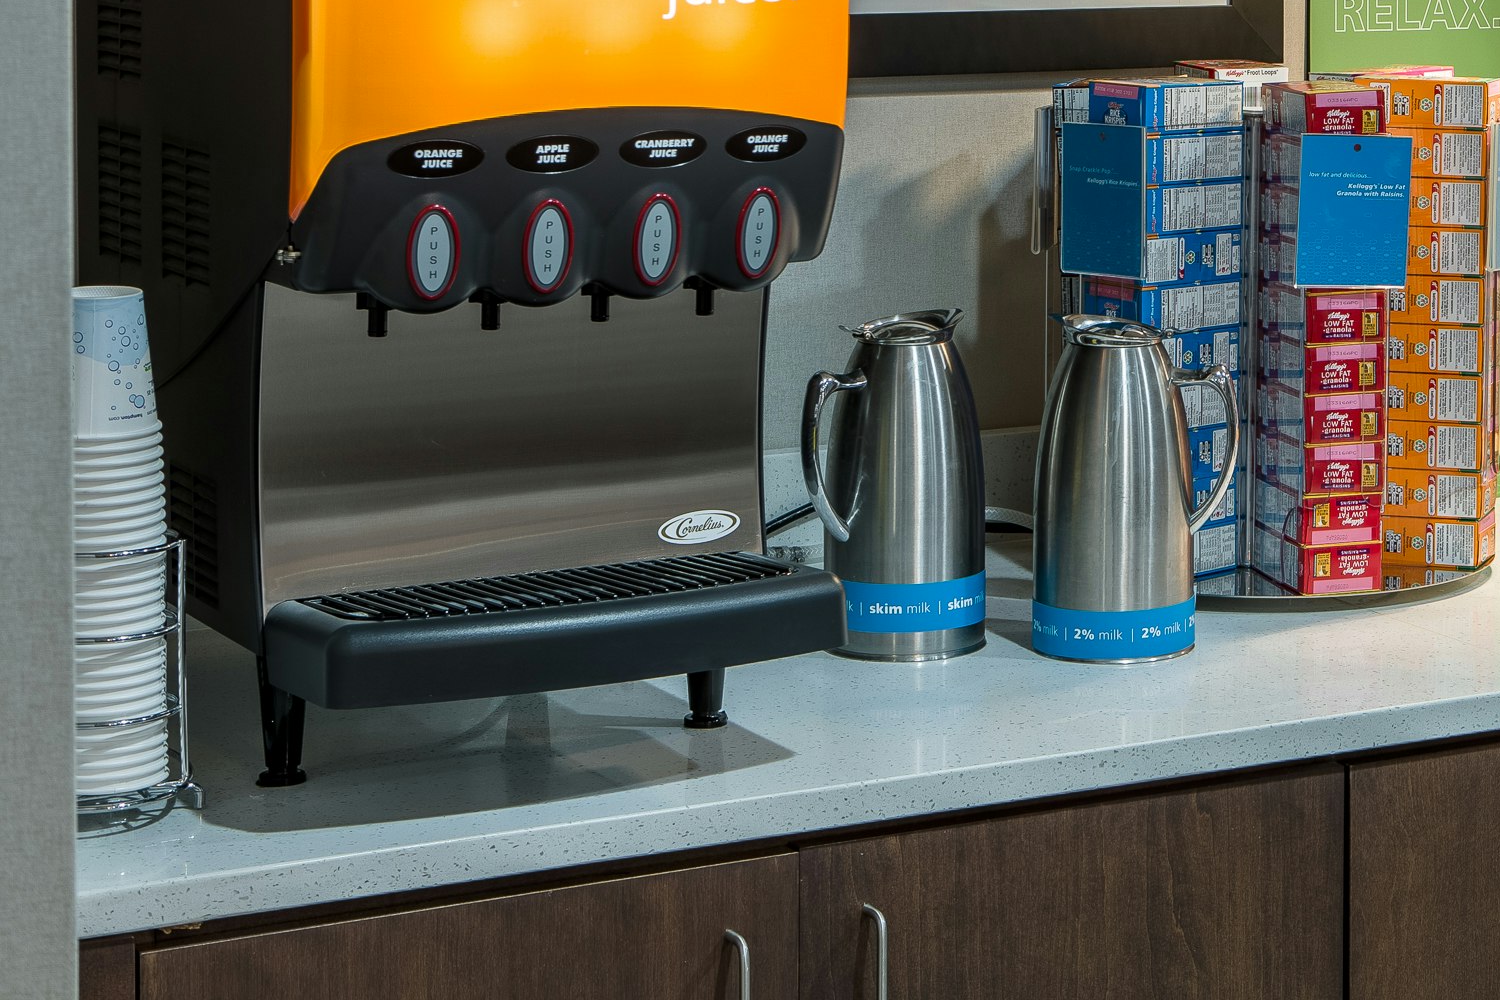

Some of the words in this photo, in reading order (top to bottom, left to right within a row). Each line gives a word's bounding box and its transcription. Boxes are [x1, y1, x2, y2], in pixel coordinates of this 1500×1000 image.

[1261, 69, 1277, 77] Loops
[1324, 123, 1352, 131] granola
[634, 138, 695, 148] CRANBERRY
[747, 134, 788, 144] ORANGE
[414, 149, 463, 158] ORANGE
[535, 144, 570, 154] APPLE
[649, 148, 678, 158] JUICE
[752, 144, 779, 153] JUICE
[422, 159, 453, 168] JUICE
[536, 154, 567, 164] JUICE
[753, 208, 765, 258] PUSH
[651, 215, 662, 266] PUSH
[543, 221, 553, 272] PUSH
[428, 226, 438, 279] PUSH
[1326, 325, 1352, 334] granola
[1324, 426, 1350, 434] granola
[1324, 476, 1351, 484] granola
[1340, 504, 1366, 513] granola
[1341, 554, 1367, 563] granola
[869, 602, 903, 614] skim
[906, 602, 931, 614] milk
[947, 596, 973, 611] skim
[1042, 624, 1059, 637] milk
[1074, 628, 1094, 640] 2%
[1098, 629, 1123, 640] milk
[1141, 626, 1161, 639] 2%
[1164, 622, 1181, 636] milk
